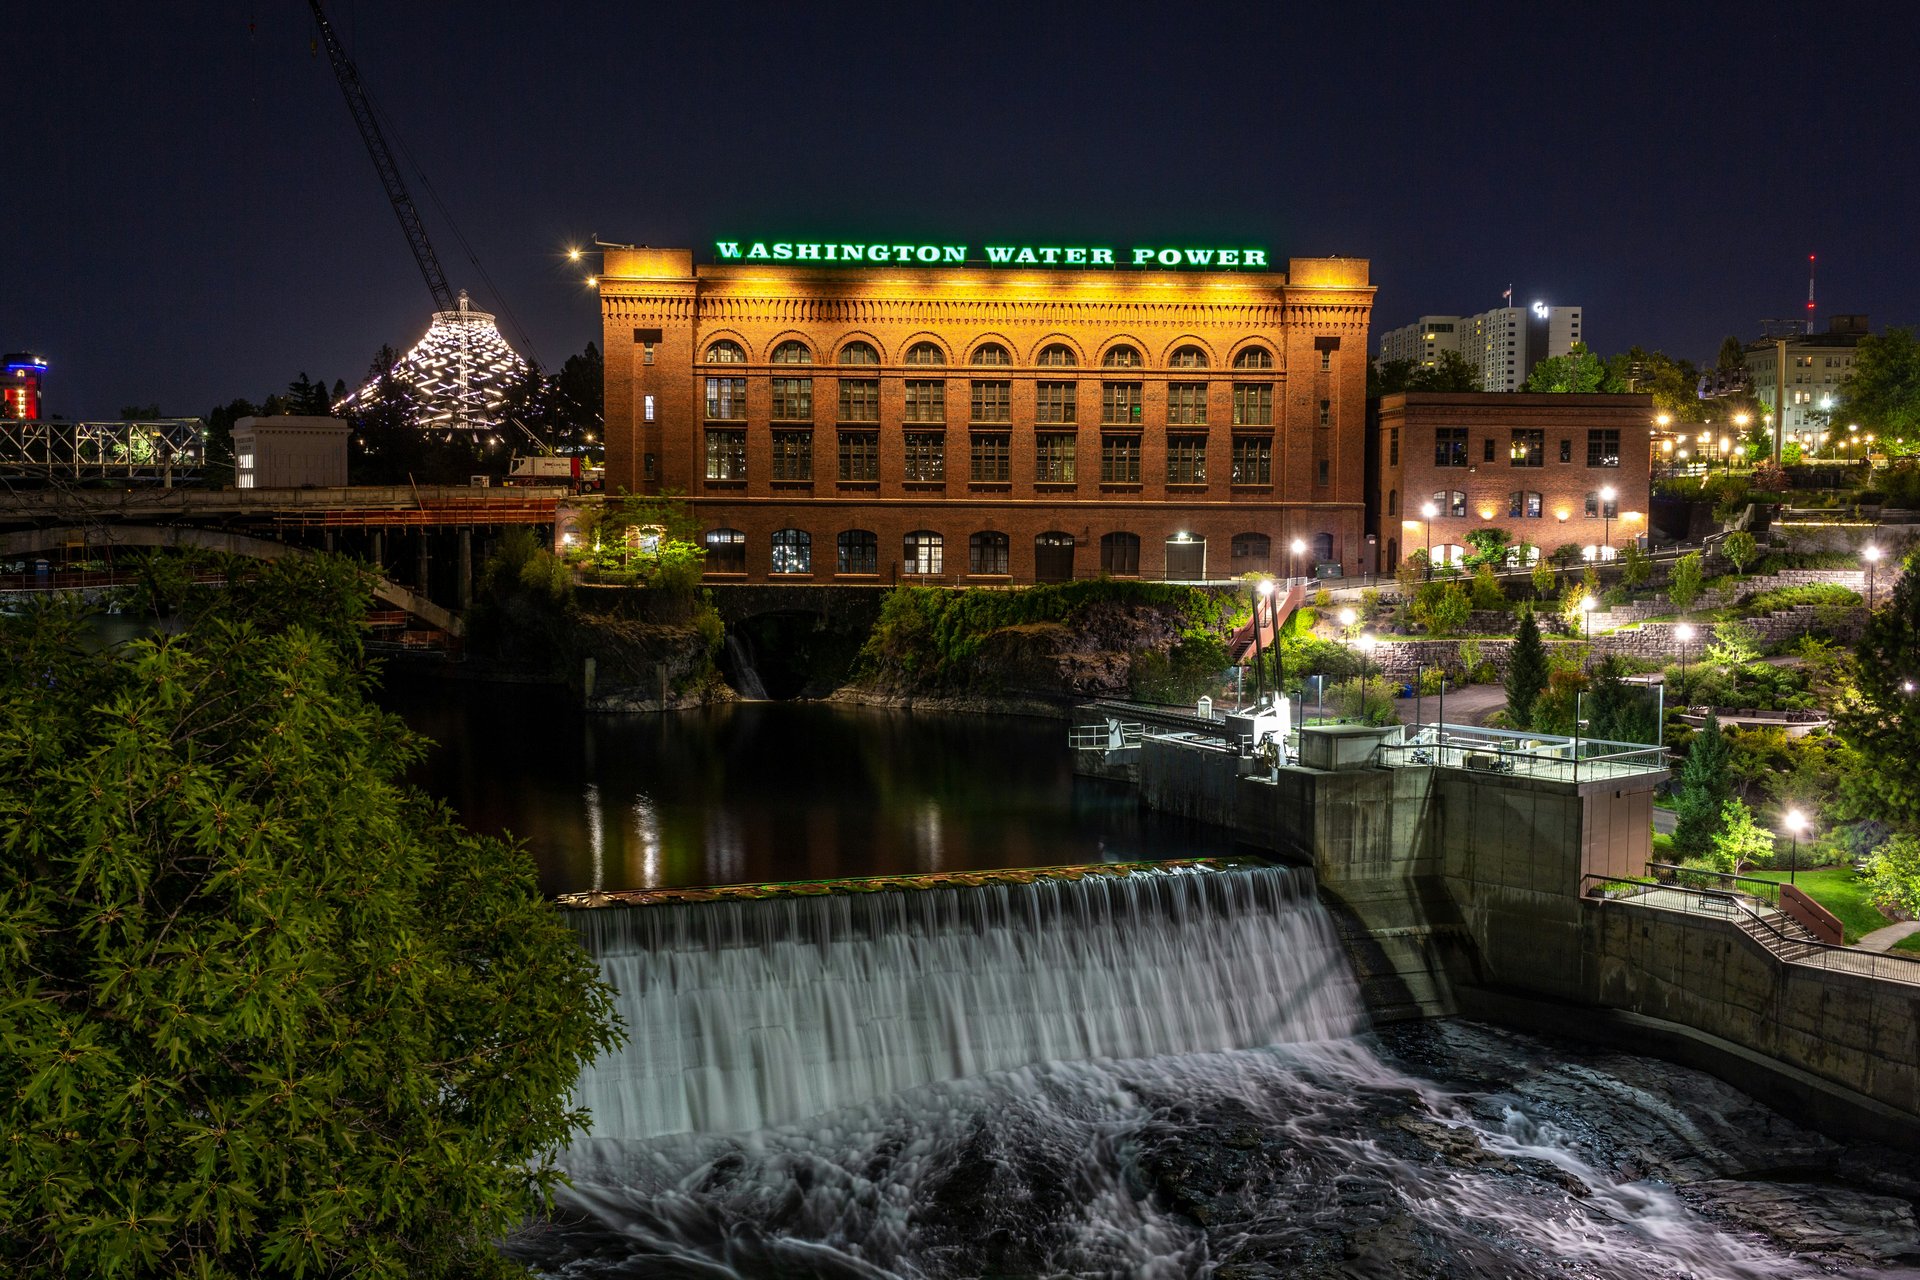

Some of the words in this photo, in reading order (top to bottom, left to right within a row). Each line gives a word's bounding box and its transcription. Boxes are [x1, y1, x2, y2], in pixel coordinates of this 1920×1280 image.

[716, 242, 967, 262] WASHINGTON
[985, 247, 1115, 263] WATER
[1132, 249, 1267, 265] POWER
